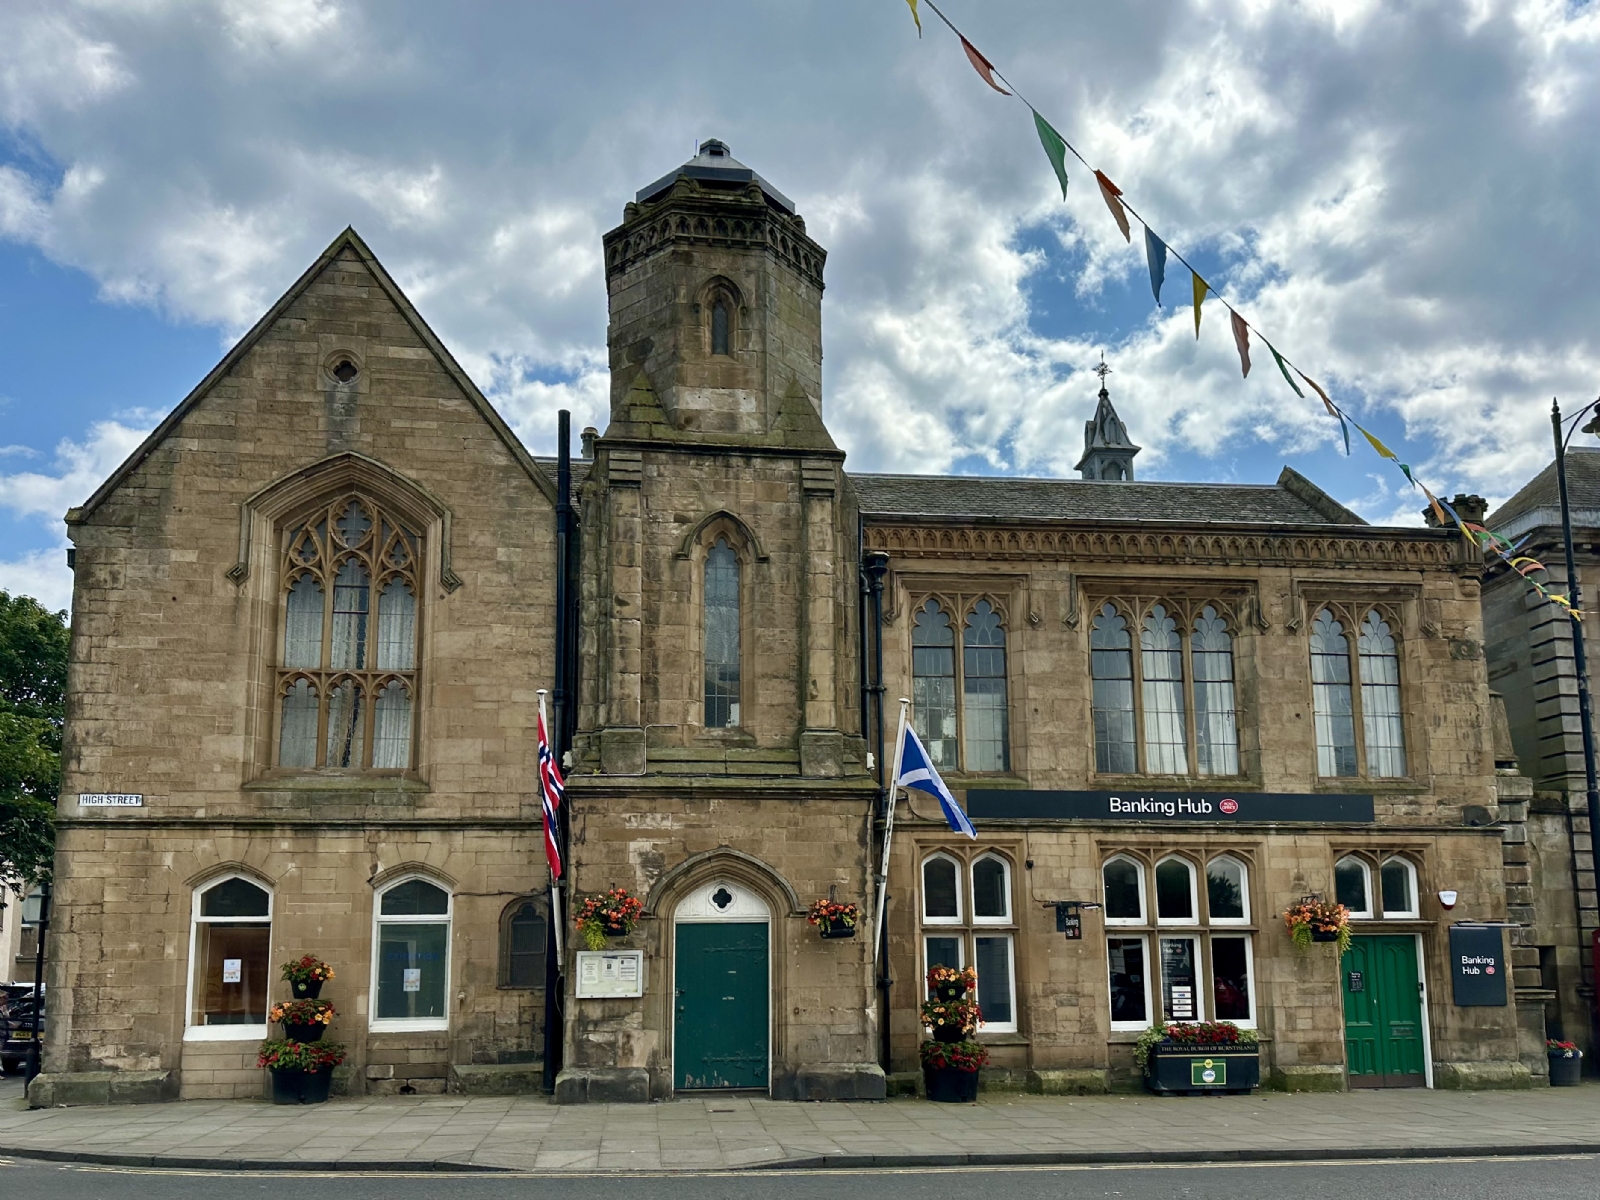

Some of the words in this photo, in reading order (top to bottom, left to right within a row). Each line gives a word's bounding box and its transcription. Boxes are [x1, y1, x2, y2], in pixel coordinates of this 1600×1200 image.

[82, 795, 103, 804] HIGH
[106, 795, 140, 804] STREET
[1109, 797, 1175, 816] Banking
[1178, 798, 1212, 814] Hub
[1065, 917, 1079, 928] Banking
[1461, 955, 1495, 966] Banking
[1462, 966, 1480, 975] Hub
